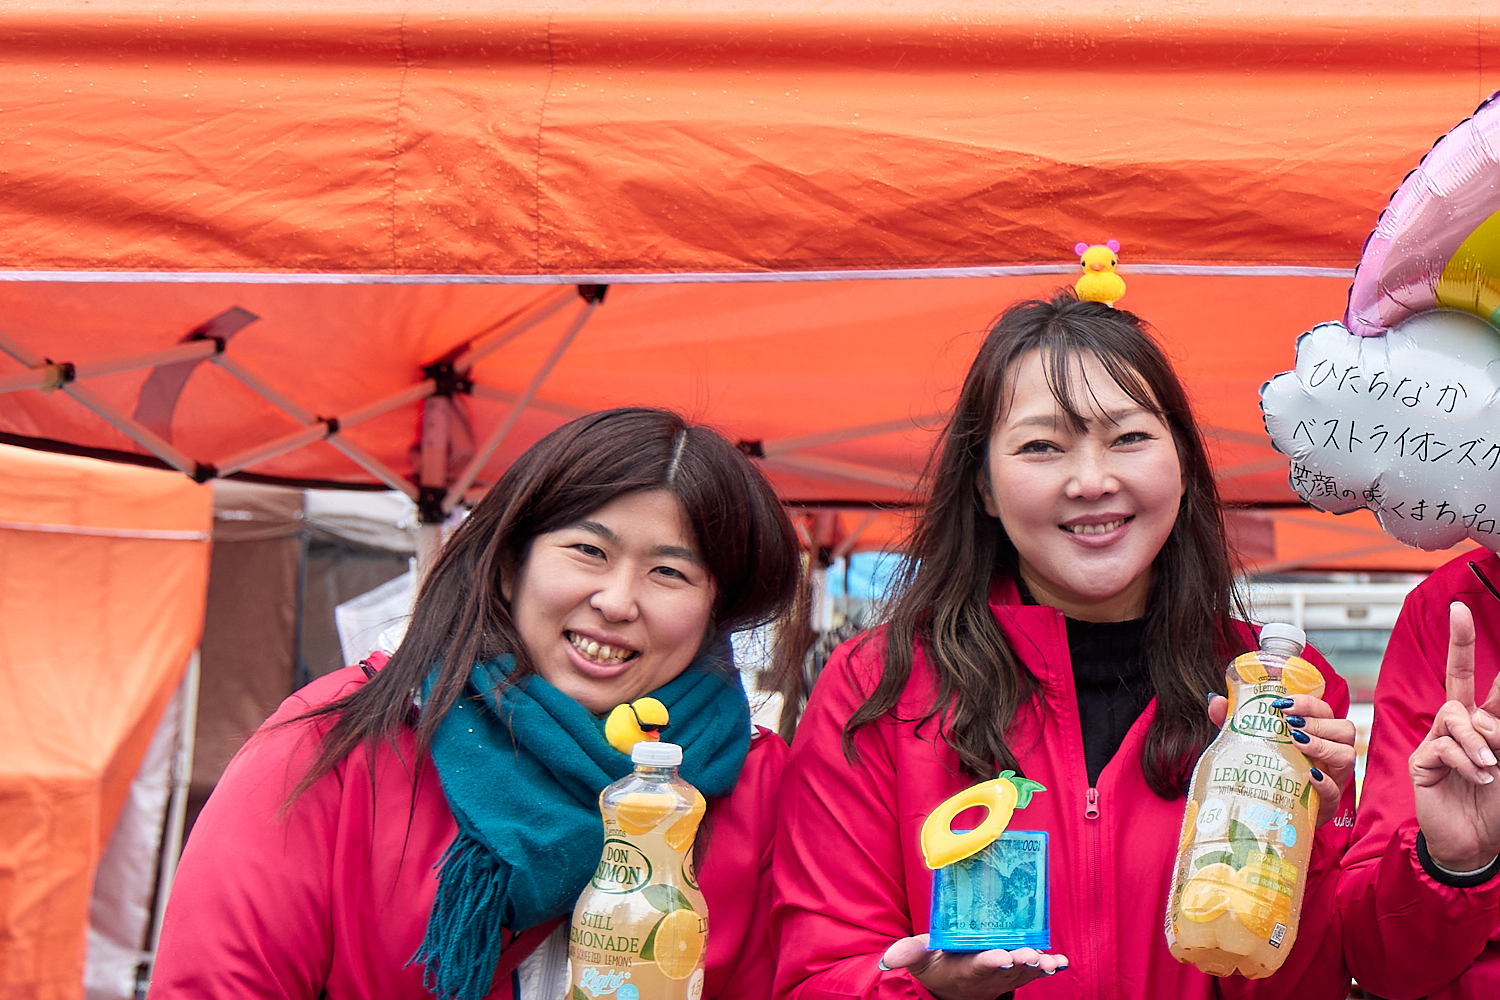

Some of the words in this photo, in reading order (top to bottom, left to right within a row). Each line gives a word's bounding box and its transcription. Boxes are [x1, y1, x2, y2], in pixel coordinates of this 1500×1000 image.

[1309, 359, 1468, 413] ひたちなか
[1243, 752, 1283, 772] STILL
[1213, 767, 1302, 798] LEMONADE
[1218, 785, 1234, 796] WITH
[1236, 785, 1269, 801] SQUEEZED
[1272, 792, 1296, 810] LEMONS
[606, 846, 630, 864] DON
[594, 860, 642, 885] SIMON
[580, 911, 614, 931] STILL
[570, 923, 640, 953] EMONADE
[576, 947, 602, 964] SQUEEZED
[604, 953, 633, 968] LEMONS
